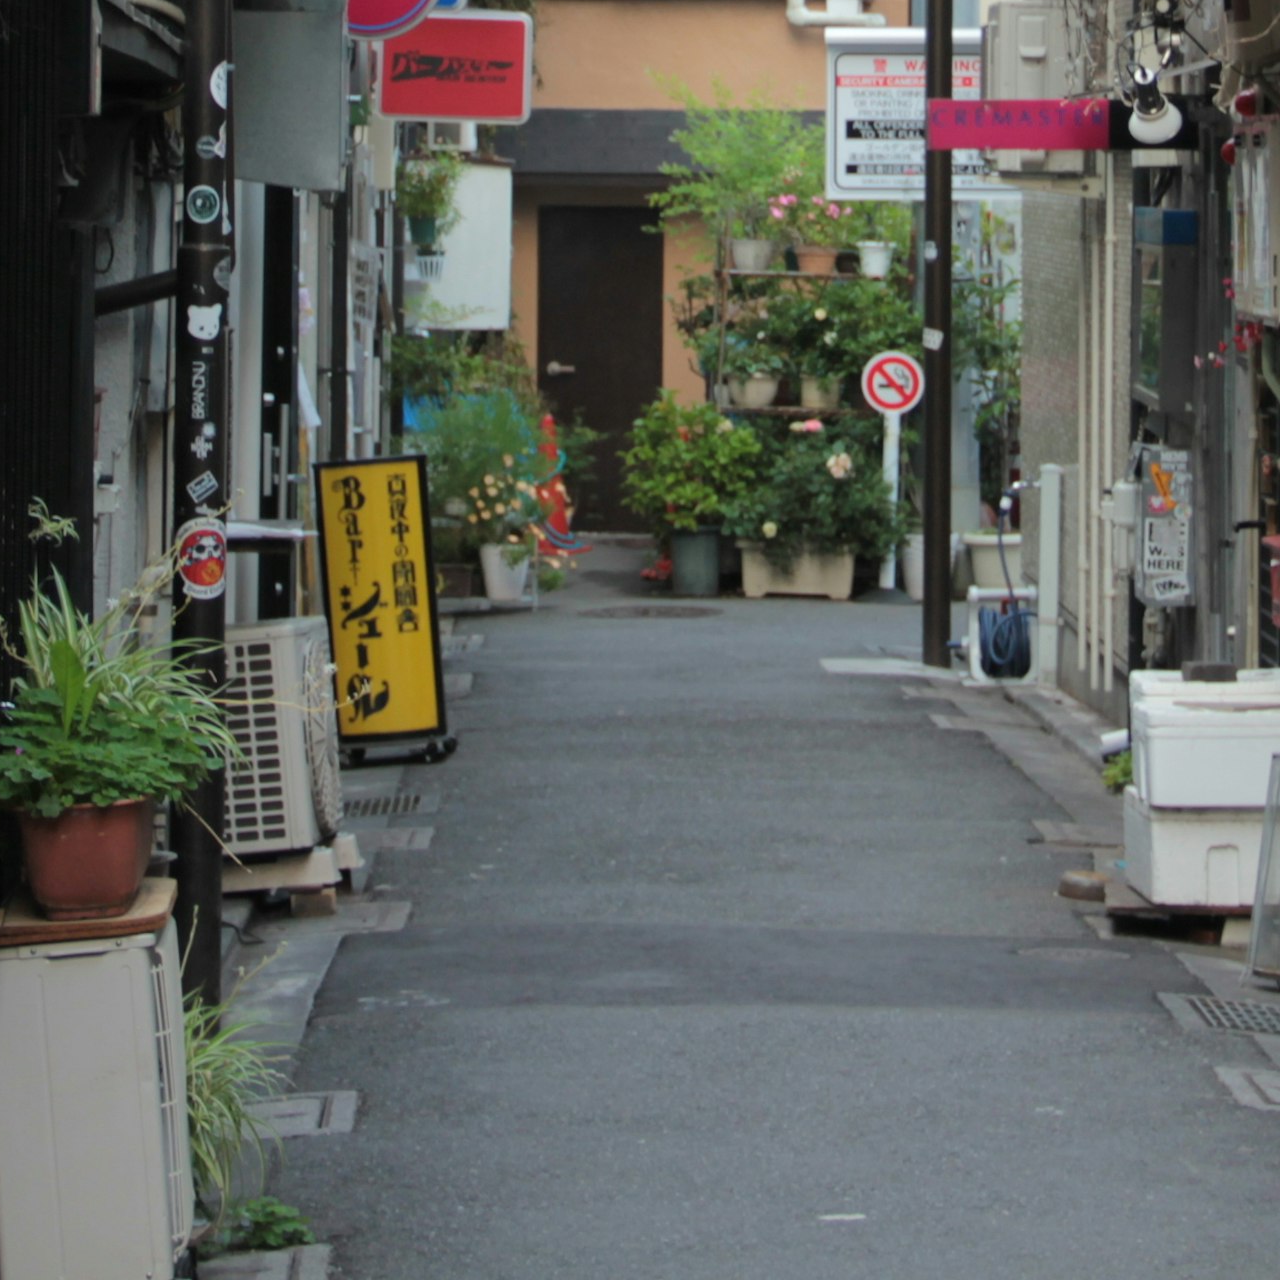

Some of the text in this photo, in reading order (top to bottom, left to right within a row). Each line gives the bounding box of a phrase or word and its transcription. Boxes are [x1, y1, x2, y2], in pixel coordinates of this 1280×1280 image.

[932, 108, 1106, 127] CREMASTER
[873, 120, 927, 130] OFFENDER
[1147, 559, 1185, 571] HERE
